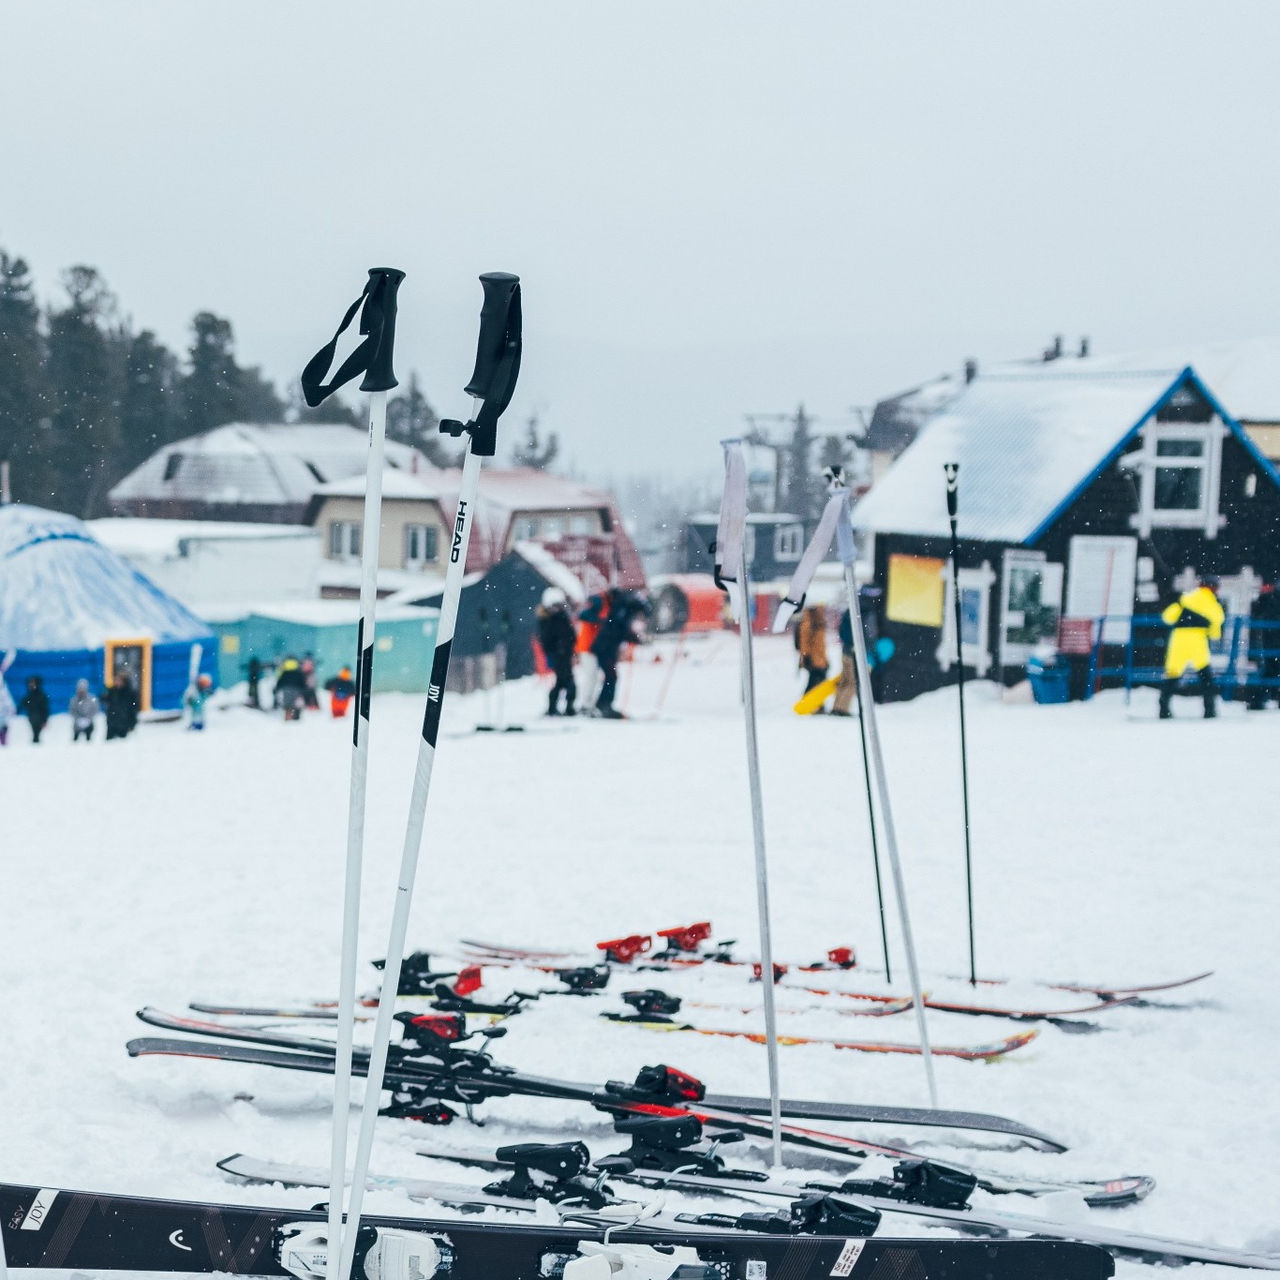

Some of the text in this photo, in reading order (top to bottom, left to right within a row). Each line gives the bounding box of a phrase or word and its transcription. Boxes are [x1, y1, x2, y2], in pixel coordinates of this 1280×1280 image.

[450, 501, 468, 564] HEAD
[428, 683, 440, 703] JOY
[8, 1205, 25, 1230] EASY
[29, 1200, 46, 1225] JOY
